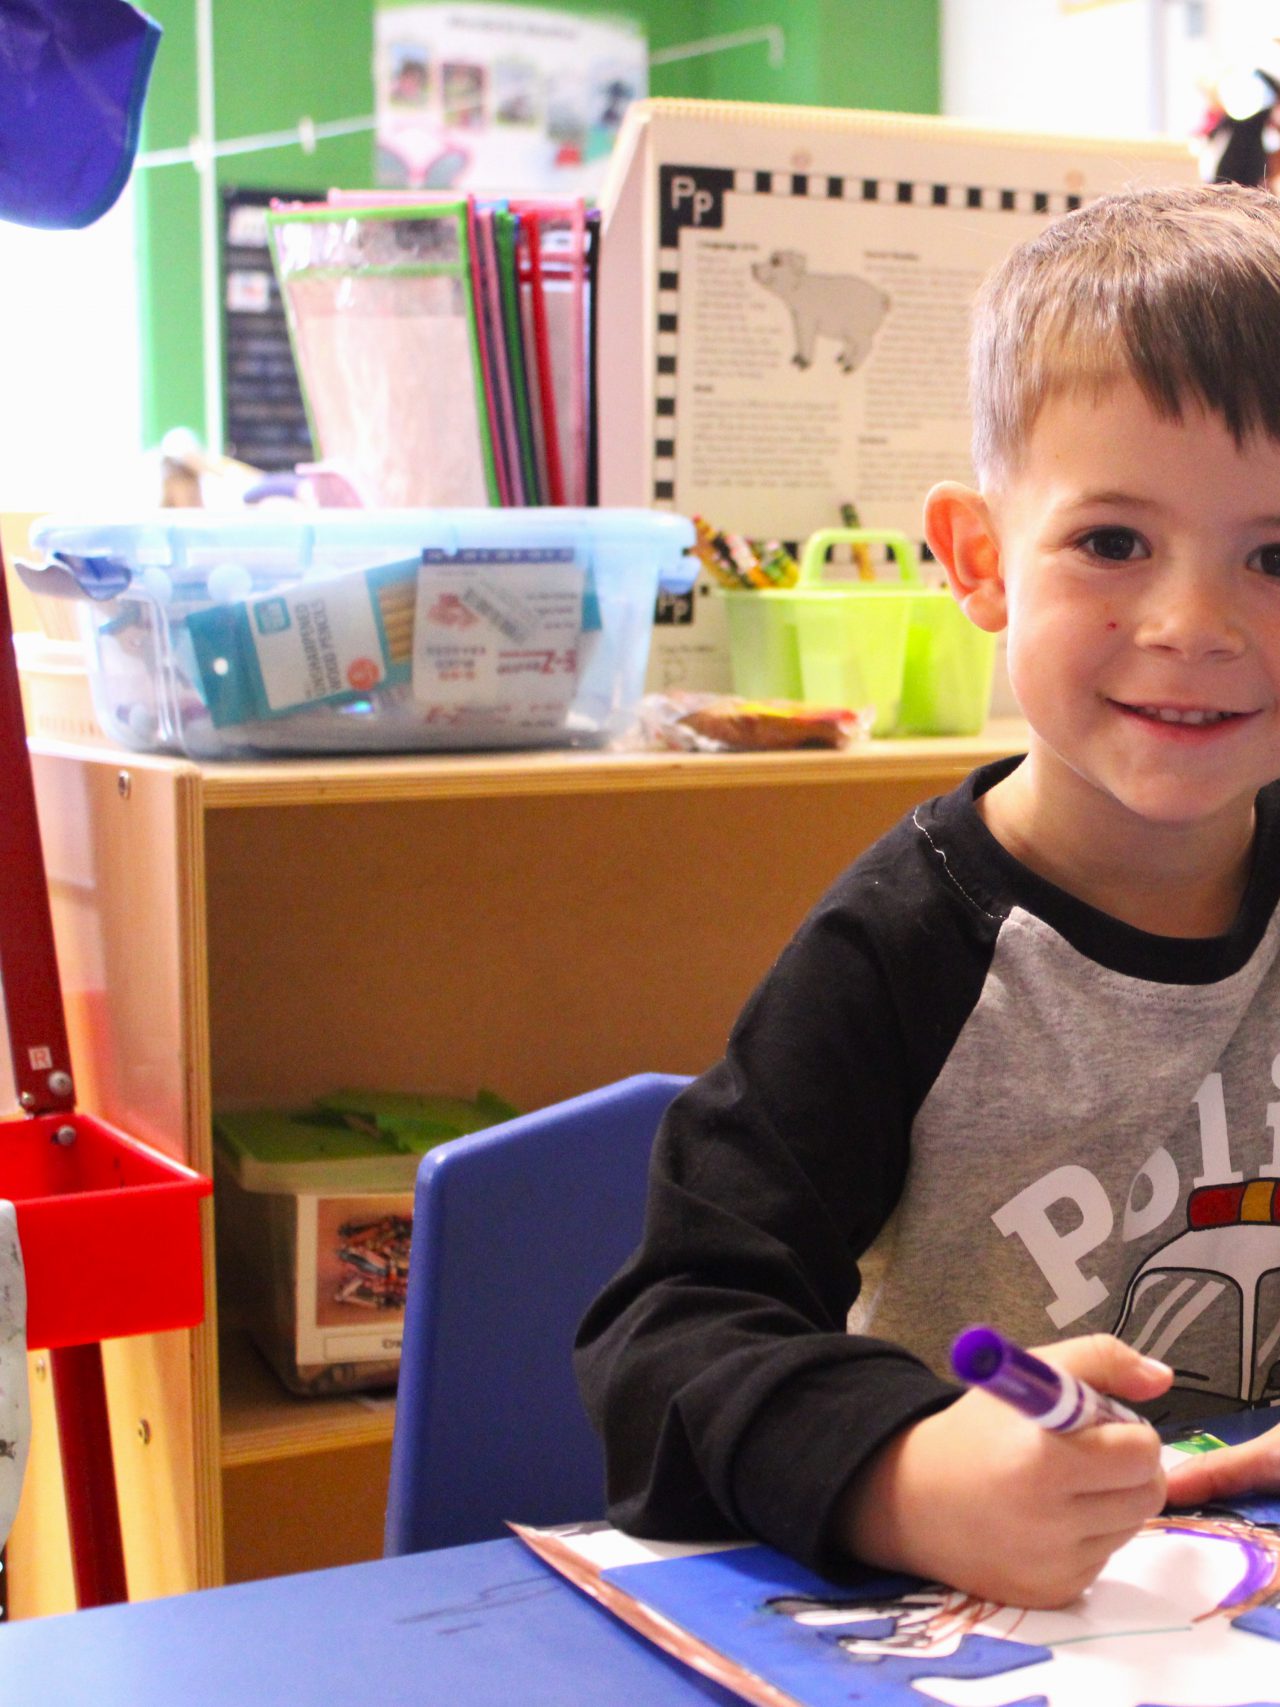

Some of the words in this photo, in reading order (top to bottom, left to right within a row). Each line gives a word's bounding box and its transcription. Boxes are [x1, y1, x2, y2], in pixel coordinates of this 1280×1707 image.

[671, 175, 714, 226] Pp
[311, 597, 334, 650] PENCILS
[322, 651, 342, 690] WOOD
